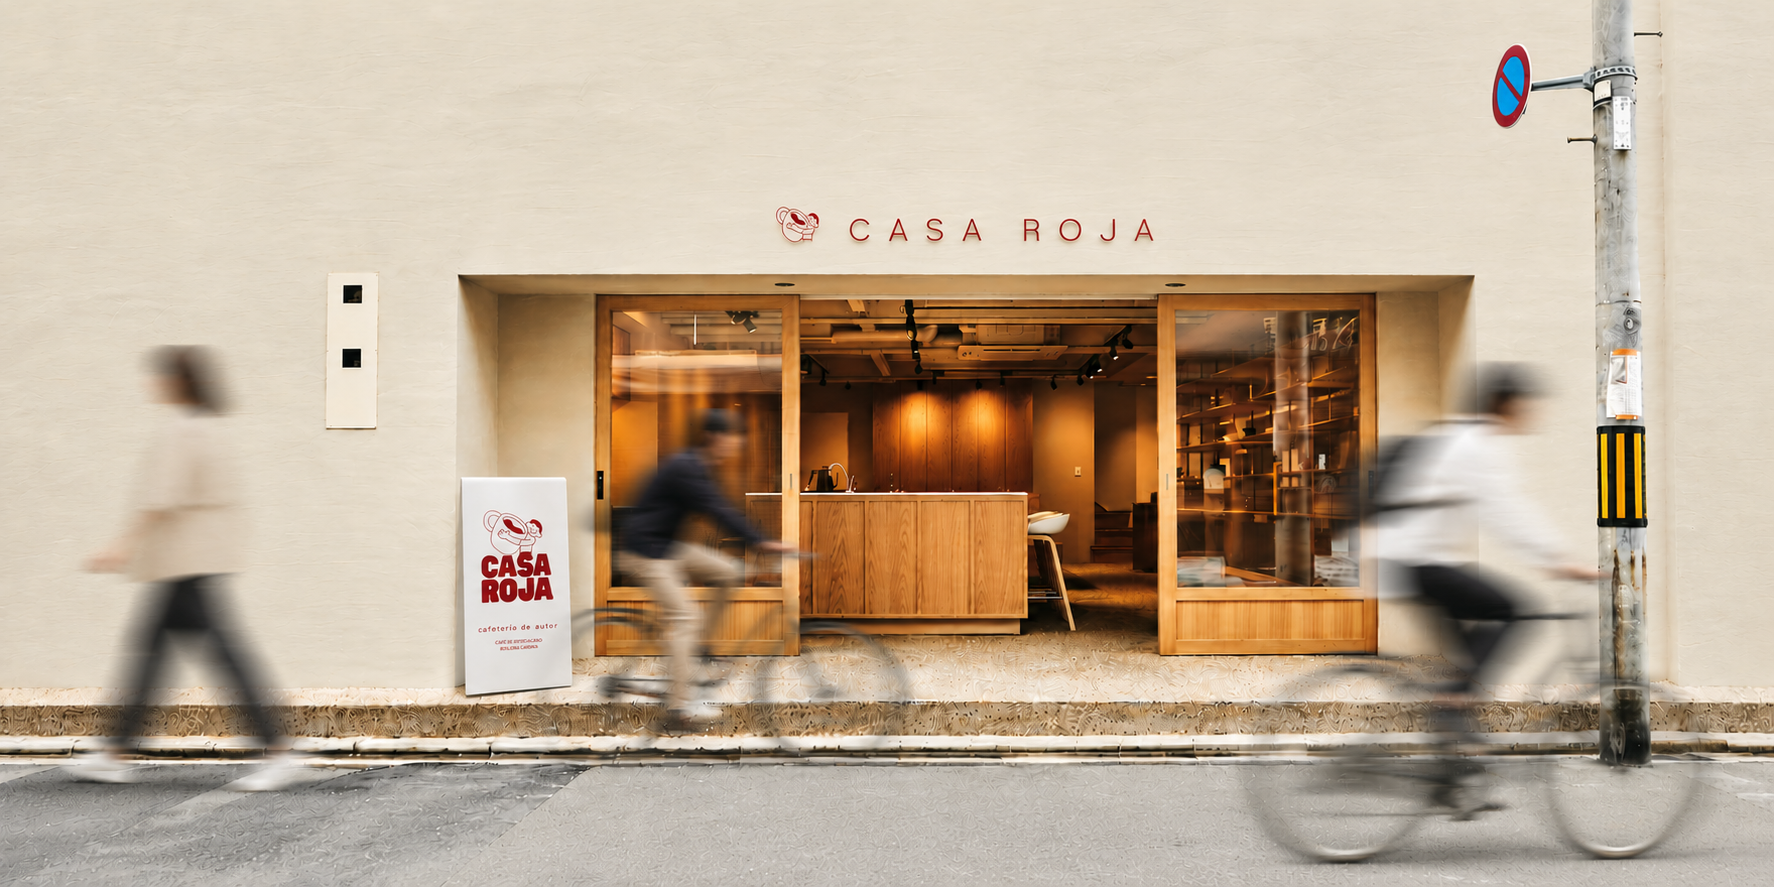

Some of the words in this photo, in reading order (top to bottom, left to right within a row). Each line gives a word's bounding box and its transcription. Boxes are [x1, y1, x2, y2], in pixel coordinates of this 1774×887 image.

[848, 217, 983, 242] CASA
[1023, 217, 1155, 242] ROJA
[481, 551, 552, 579] CASA
[481, 577, 554, 604] ROJA
